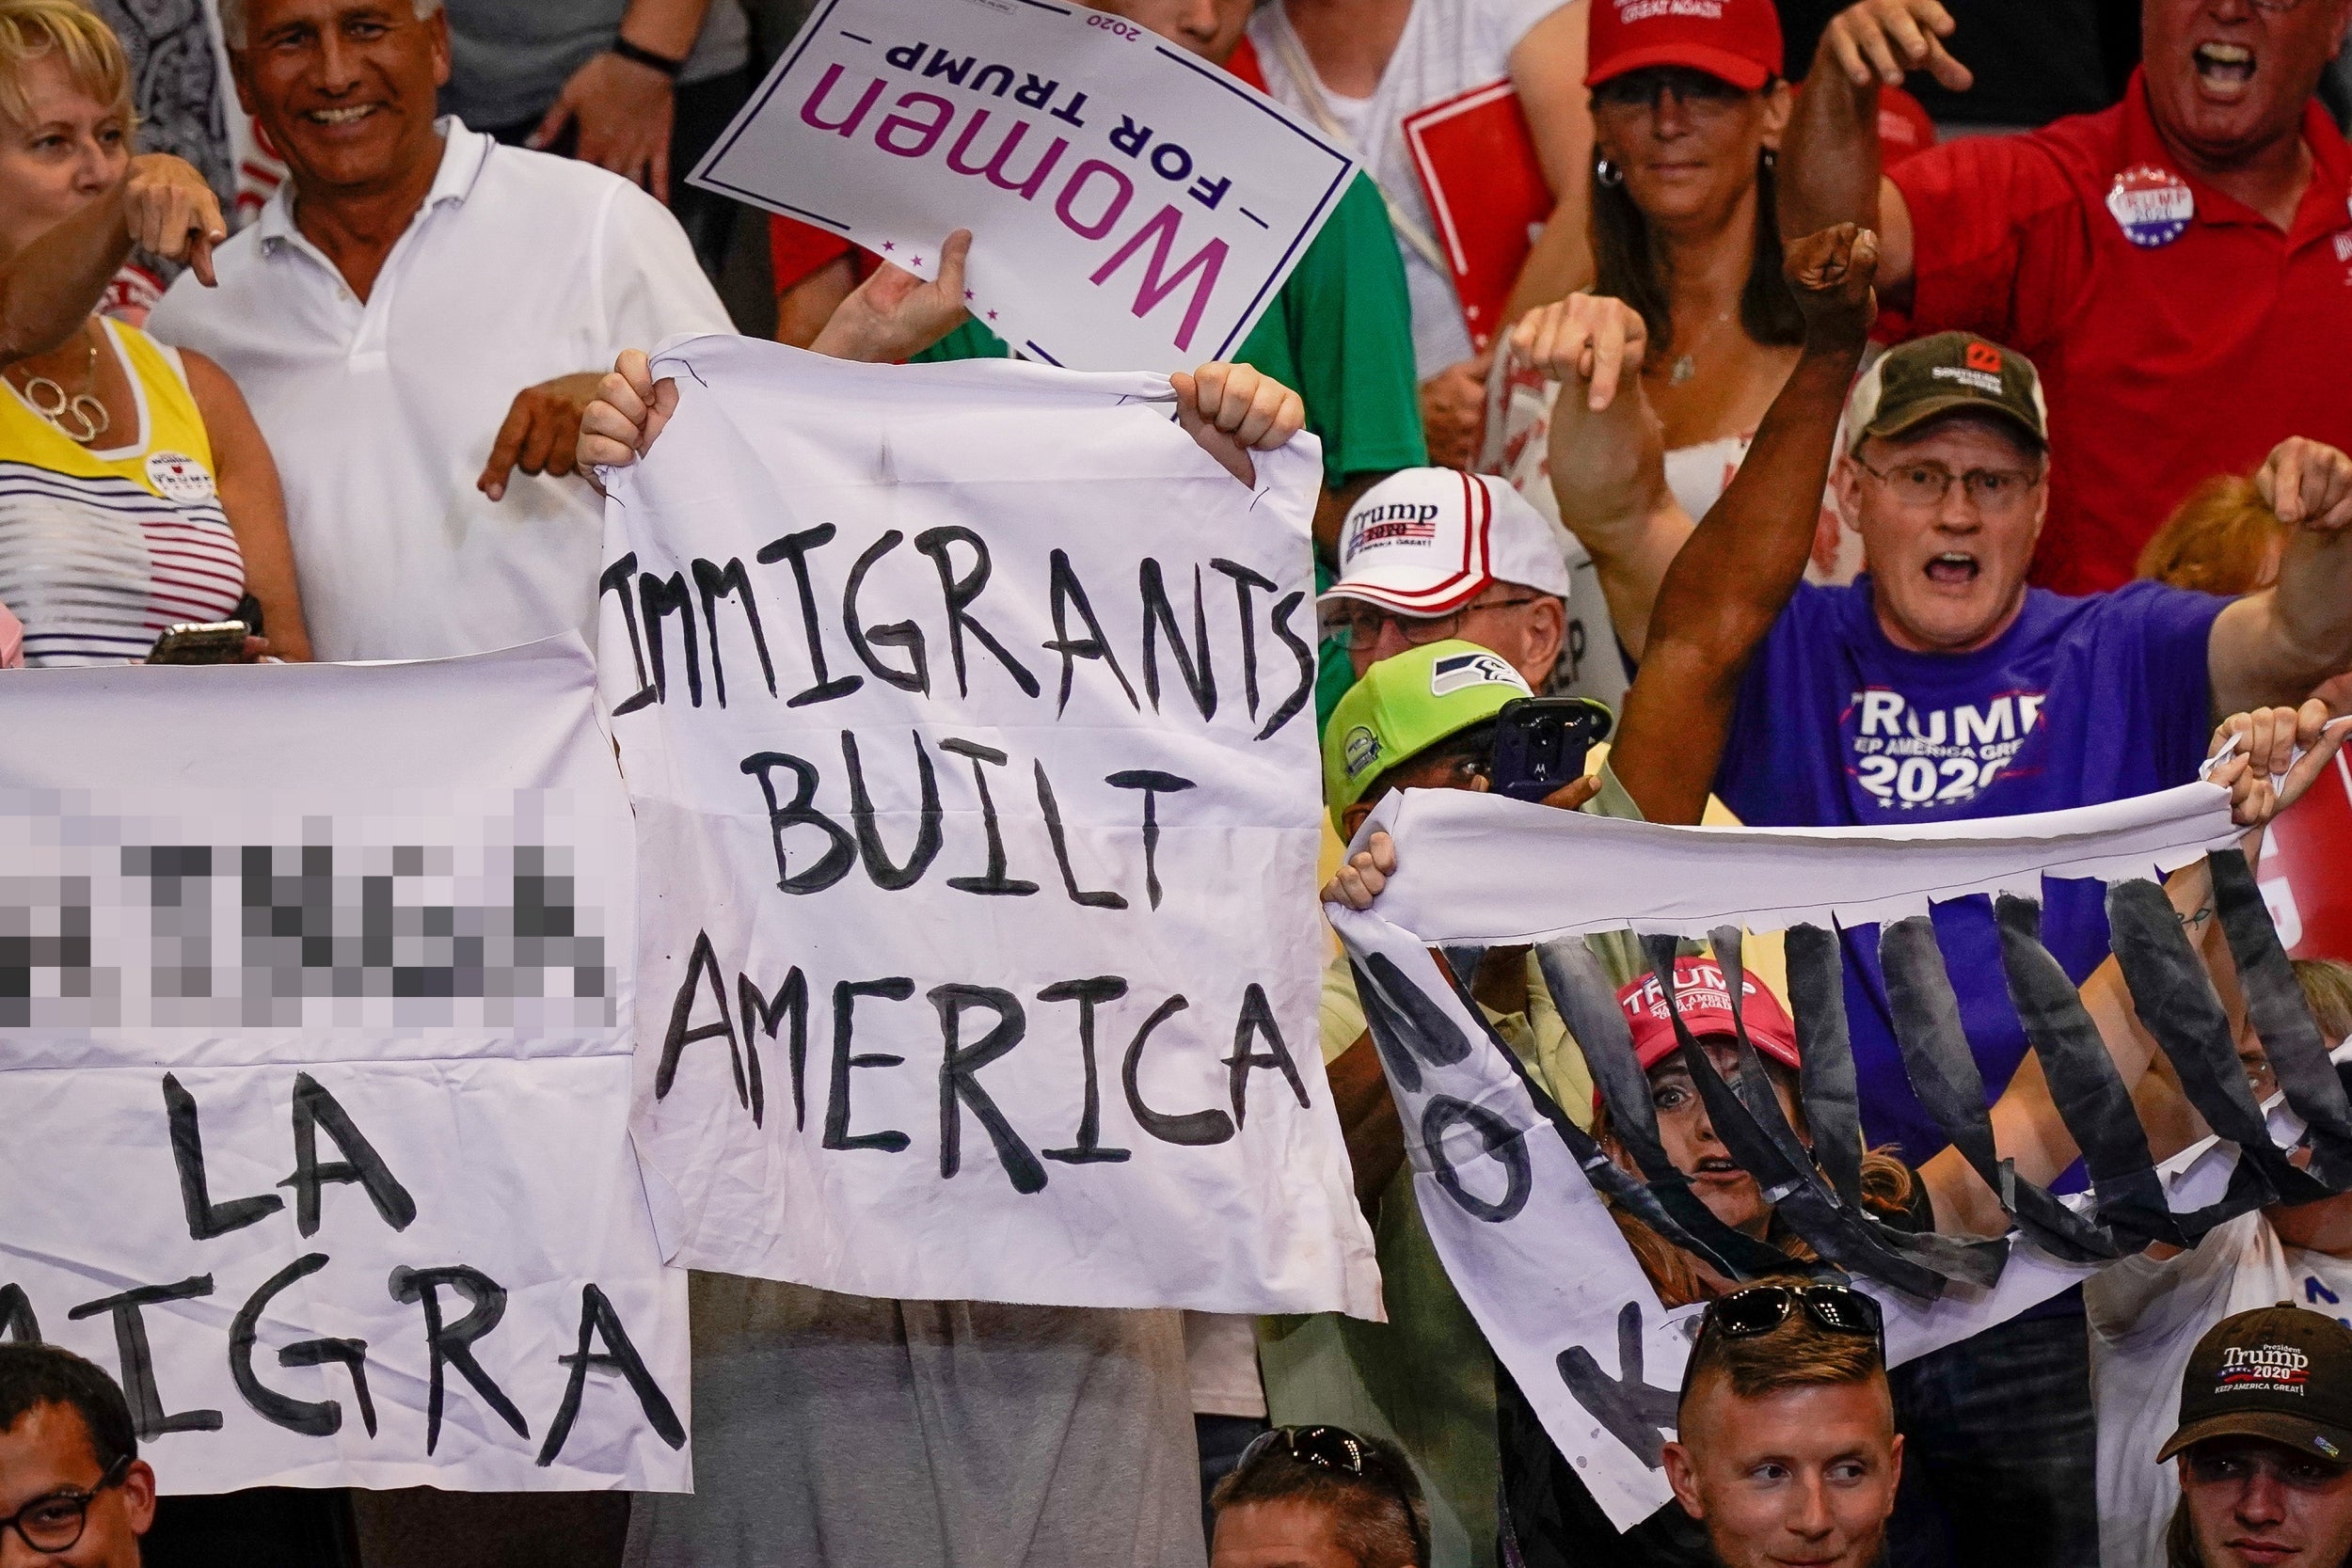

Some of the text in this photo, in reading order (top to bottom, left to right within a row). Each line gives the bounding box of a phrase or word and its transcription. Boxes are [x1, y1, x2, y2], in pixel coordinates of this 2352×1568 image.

[1087, 14, 1141, 41] 2020
[885, 41, 1232, 210] FOR TRUMP
[800, 63, 1230, 353] Women
[1353, 503, 1438, 532] Trump
[598, 523, 1320, 741] IMMIGRANTS
[1851, 689, 2046, 746] RUM
[739, 729, 1198, 912] BUILT
[654, 928, 1312, 1195] AMERICA
[162, 1069, 417, 1241] LA
[2223, 1347, 2309, 1372] Trump
[2252, 1365, 2291, 1380] 2020
[2263, 1343, 2302, 1354] President
[2215, 1383, 2304, 1397] KEEP AMERICA GREAT!
